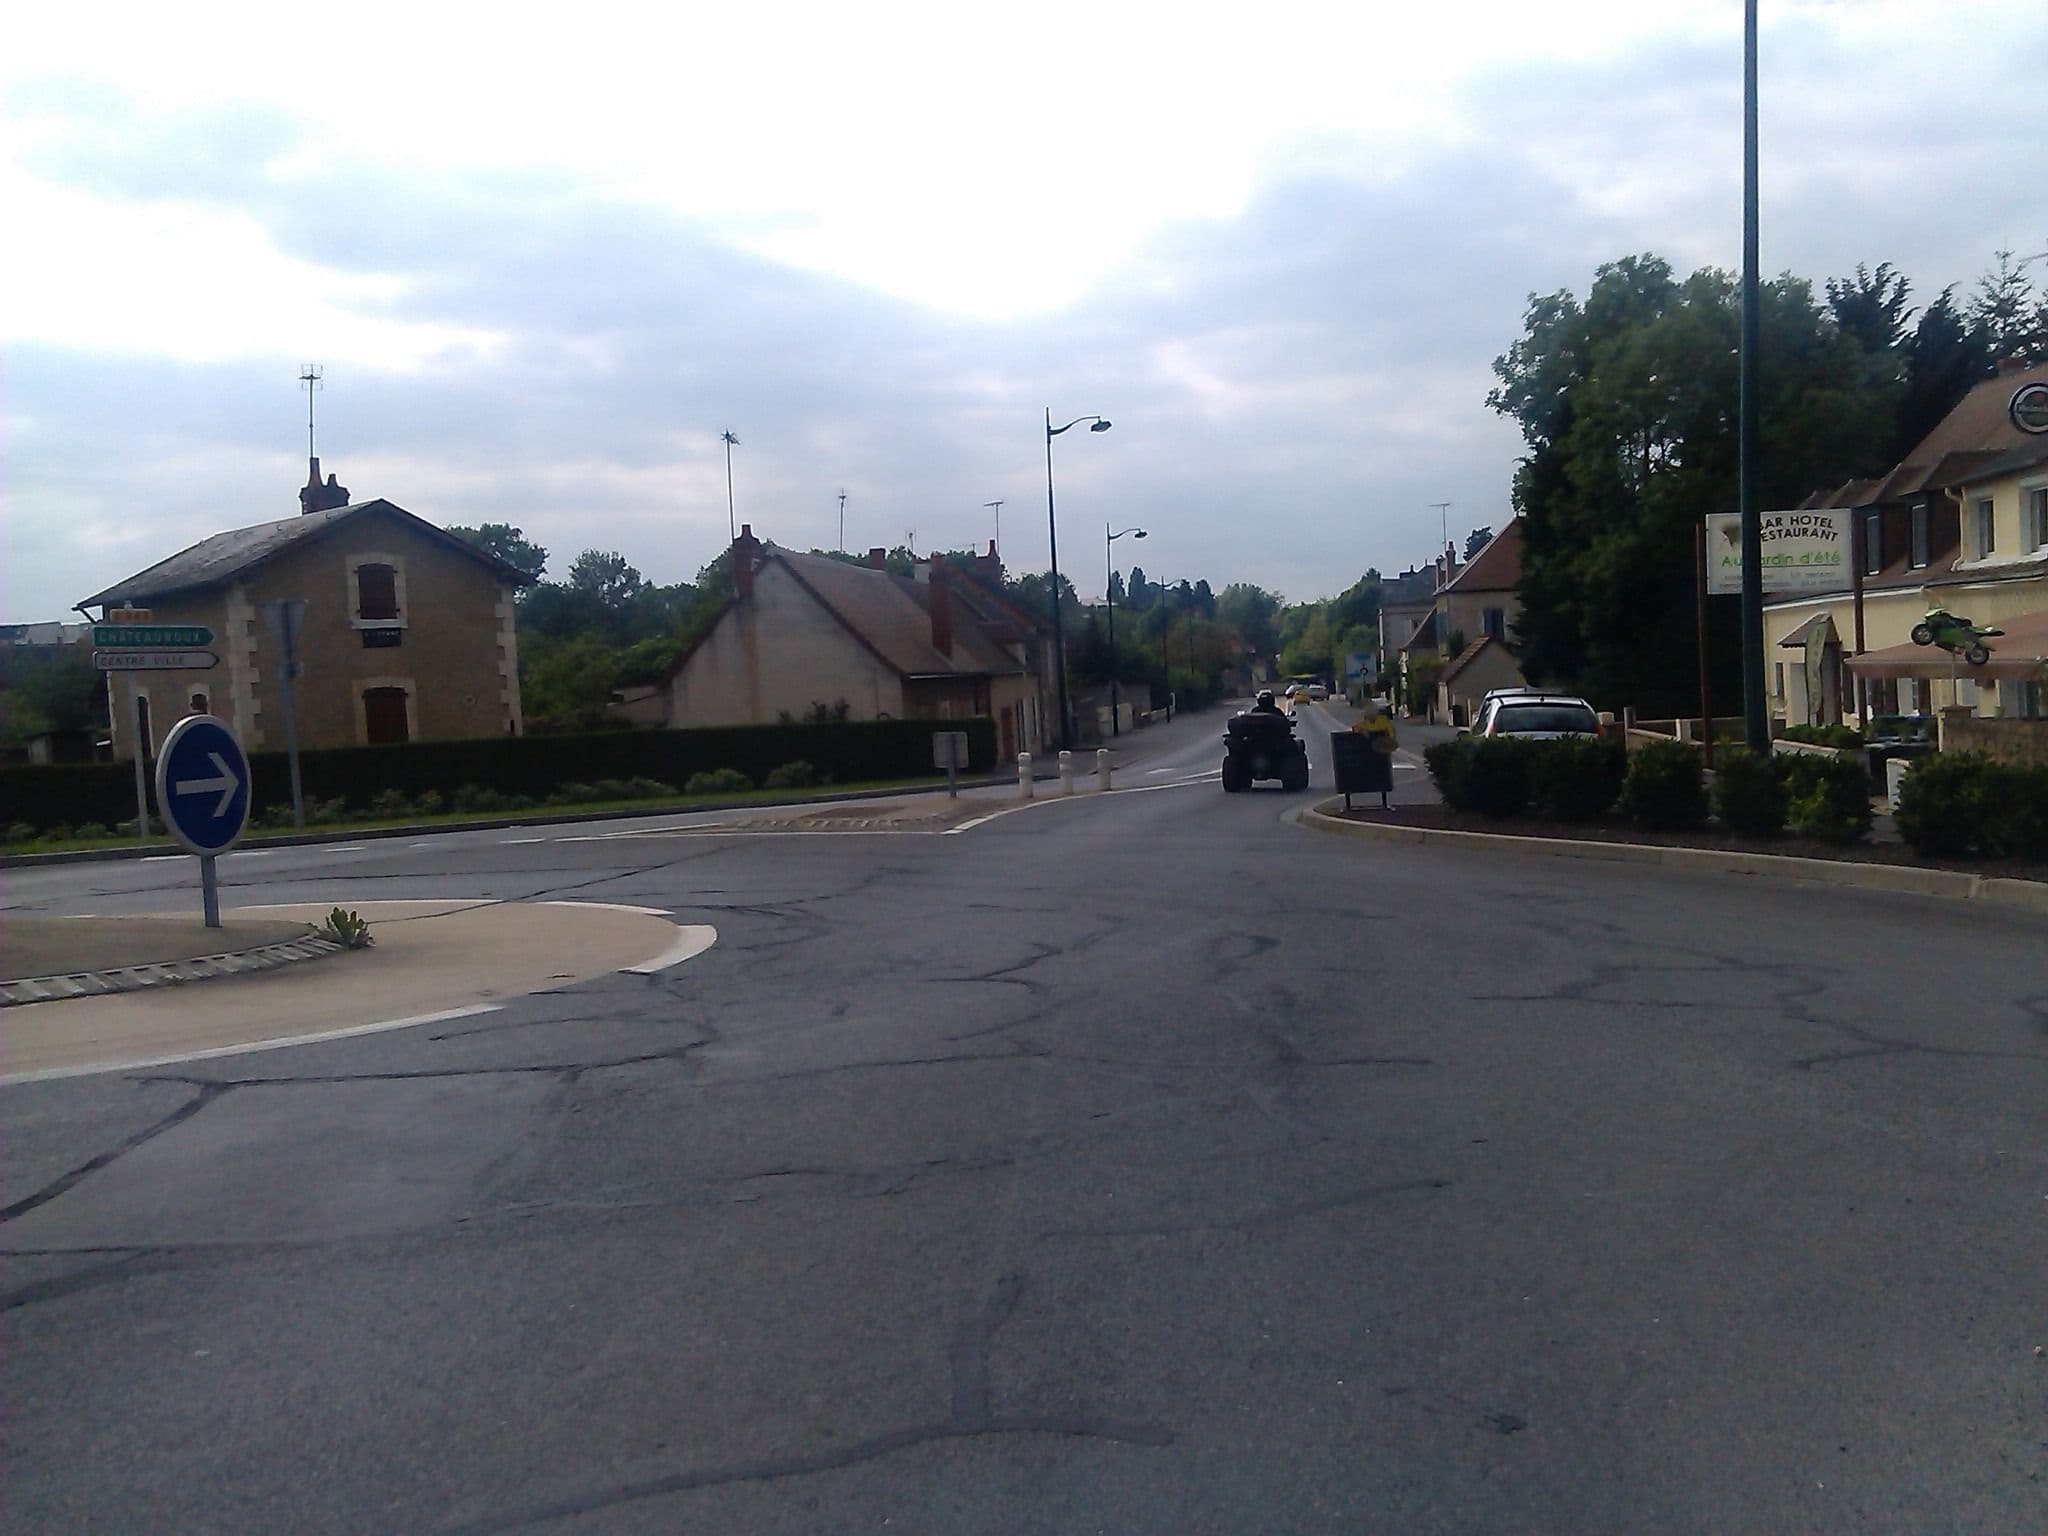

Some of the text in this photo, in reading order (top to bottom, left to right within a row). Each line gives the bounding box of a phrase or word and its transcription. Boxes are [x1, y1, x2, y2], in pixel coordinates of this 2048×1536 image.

[1790, 515, 1833, 529] HOTEL
[1760, 527, 1838, 542] ESTAURANT
[1800, 550, 1840, 564] d'été
[101, 655, 184, 666] CENTRE VILLE
